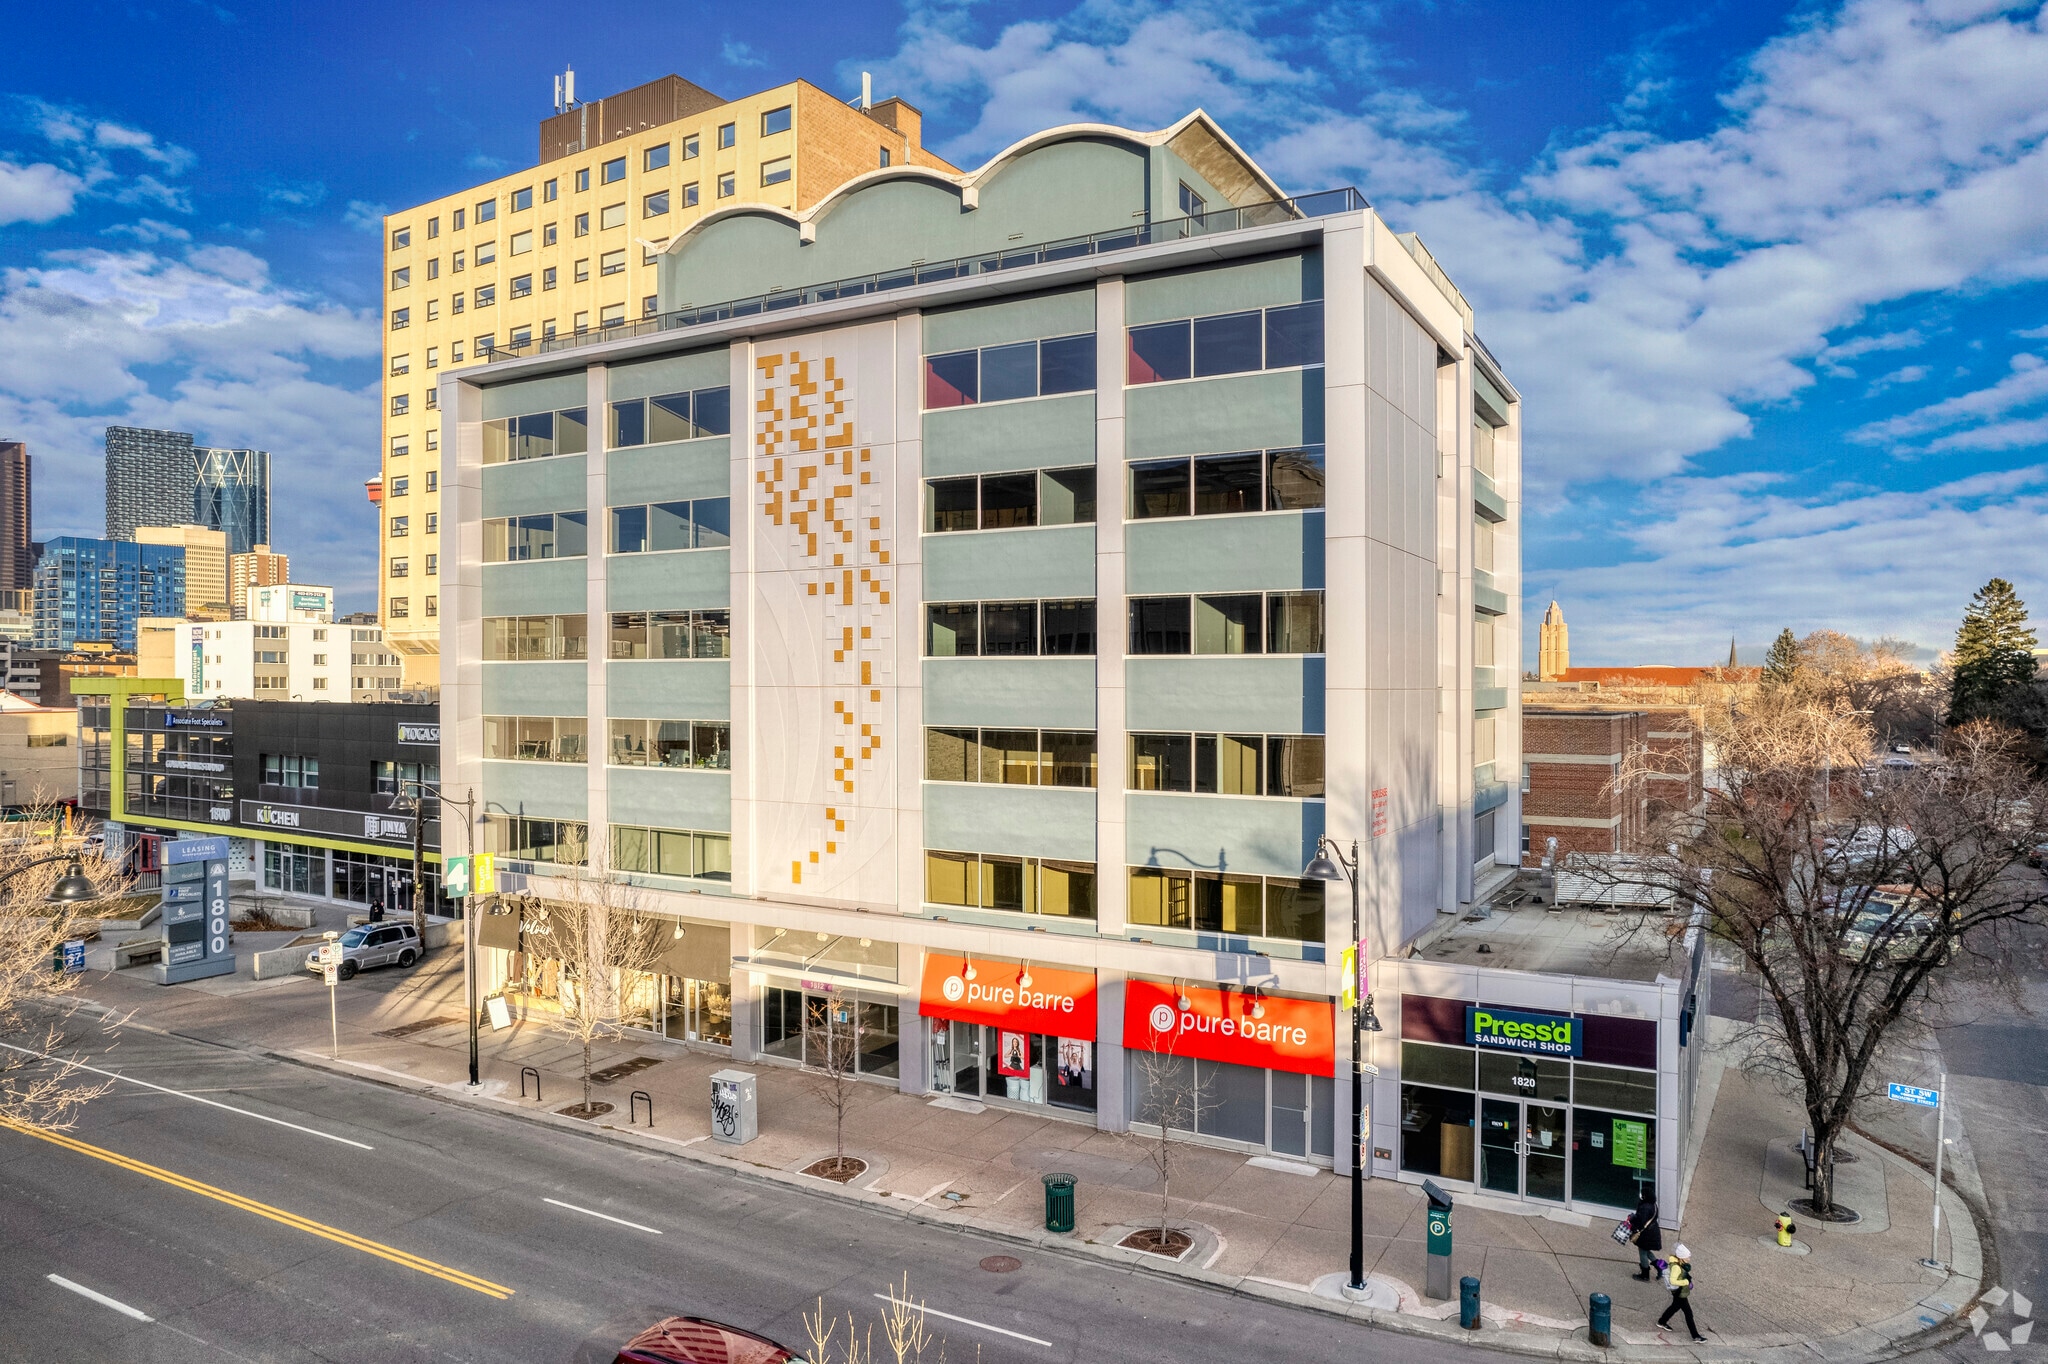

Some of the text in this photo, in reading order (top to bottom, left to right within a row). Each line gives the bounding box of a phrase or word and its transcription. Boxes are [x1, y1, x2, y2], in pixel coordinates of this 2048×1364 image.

[173, 717, 191, 725] Associate
[201, 718, 223, 726] Specialists
[210, 807, 230, 822] 1800
[257, 805, 299, 827] KÜCHEN
[381, 820, 407, 836] JINYA
[182, 845, 216, 854] LEASING
[447, 863, 468, 892] 4
[1342, 956, 1354, 1000] 4
[968, 983, 1075, 1013] pure barre
[1180, 1012, 1307, 1046] pure barre
[1474, 1012, 1571, 1044] Press'd
[1475, 1034, 1572, 1053] SANDWICH SHOP
[1511, 1076, 1536, 1088] 1820
